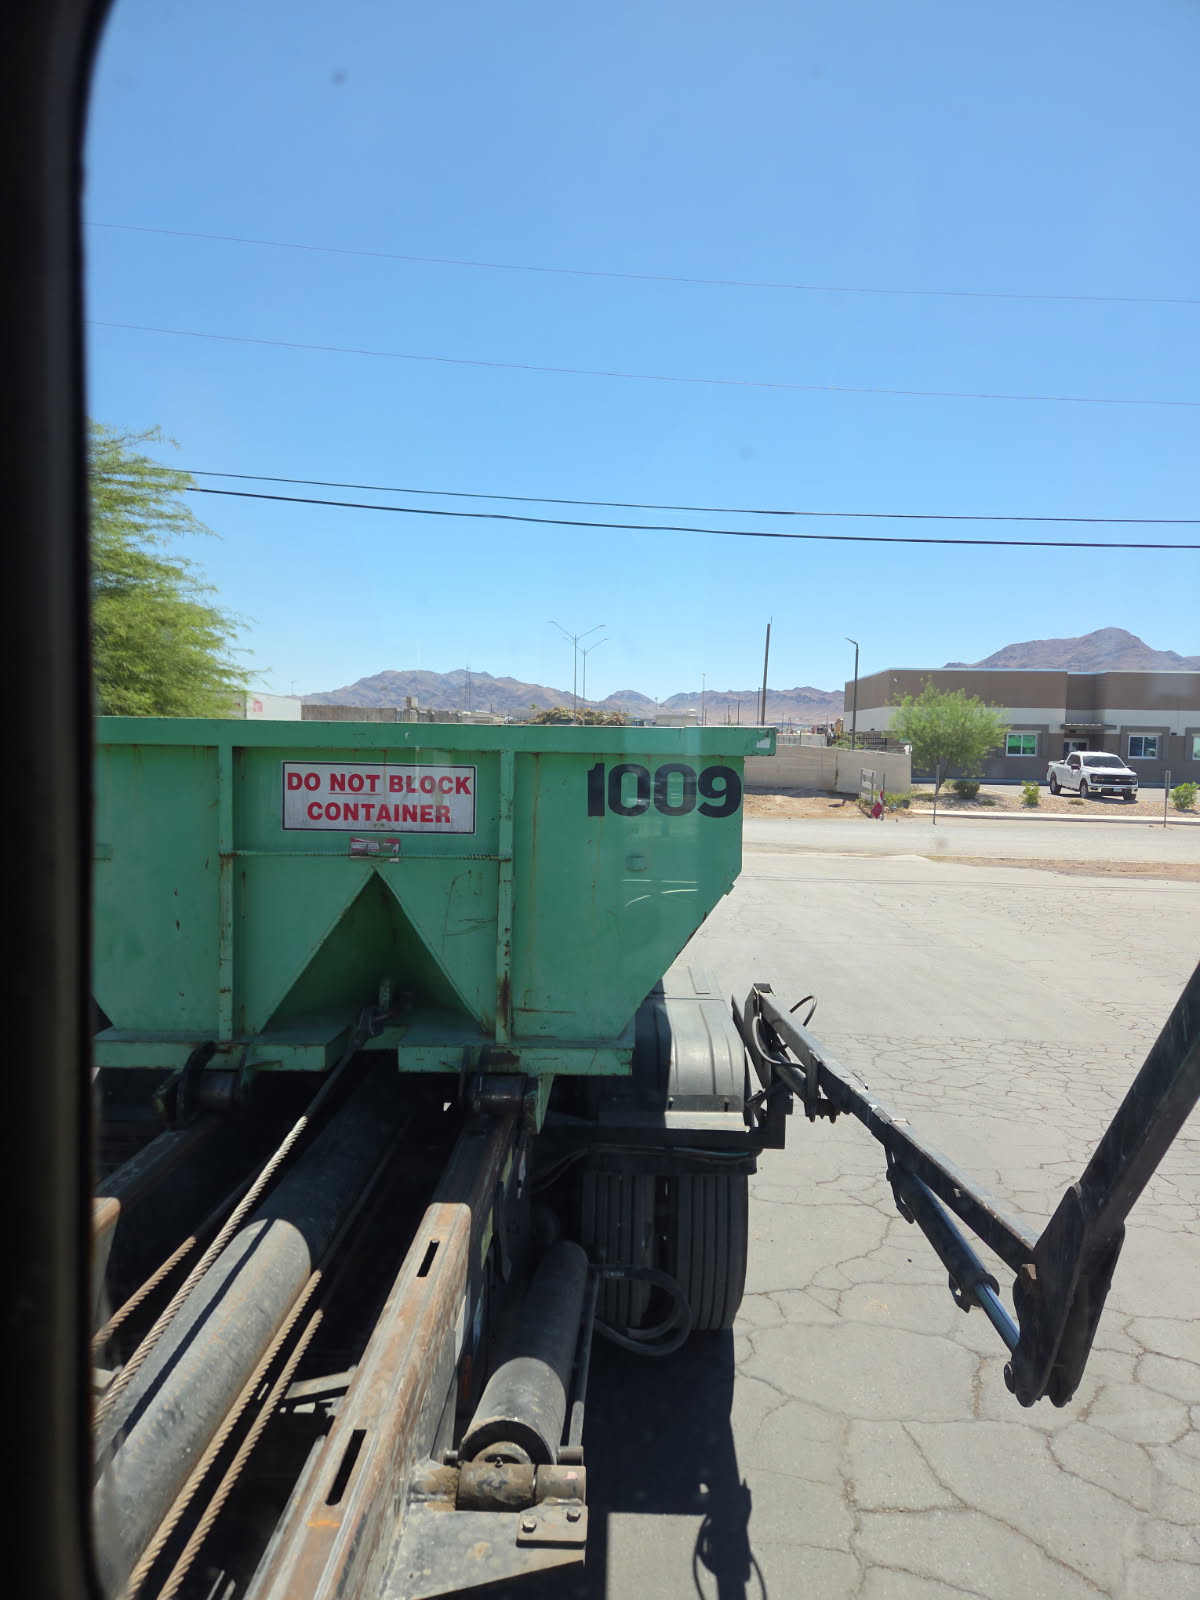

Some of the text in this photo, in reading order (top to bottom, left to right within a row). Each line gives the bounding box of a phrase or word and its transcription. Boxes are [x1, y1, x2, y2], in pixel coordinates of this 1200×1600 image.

[287, 772, 472, 795] DO NOT BLOCK
[587, 762, 742, 818] 1009
[307, 801, 451, 823] CONTAINER
